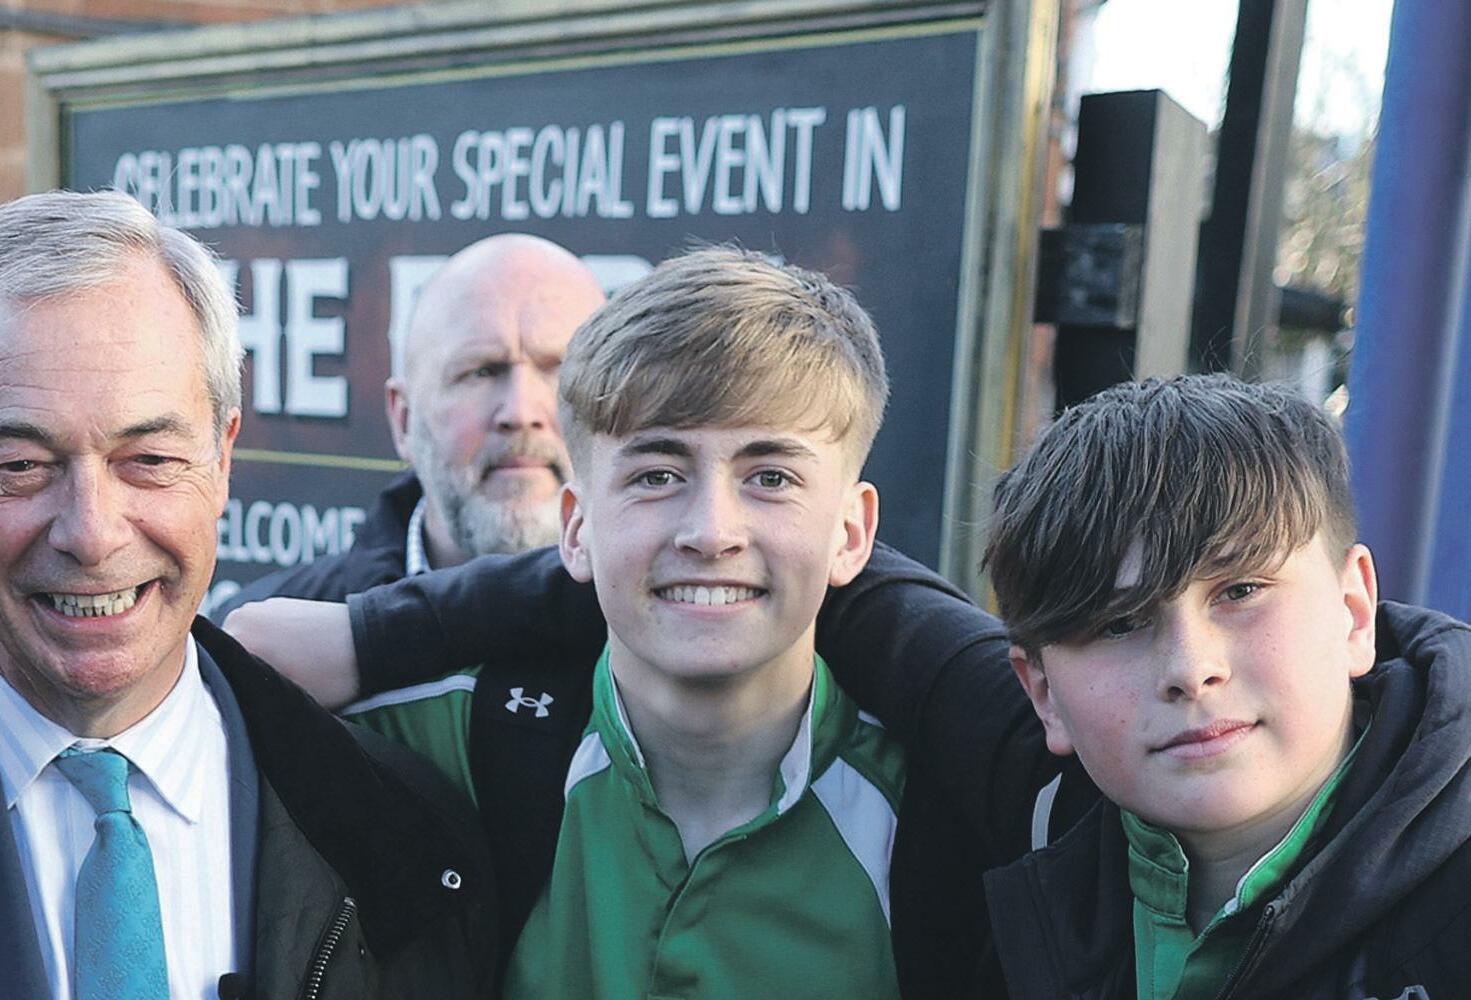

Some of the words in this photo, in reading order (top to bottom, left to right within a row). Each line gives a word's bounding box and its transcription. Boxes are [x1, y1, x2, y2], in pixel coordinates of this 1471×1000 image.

[330, 133, 441, 222] YOUR
[452, 120, 634, 220] SPECIAL
[645, 106, 827, 218] EVENT
[841, 103, 907, 212] IN
[218, 256, 349, 418] HE
[216, 498, 367, 566] ELCOME
